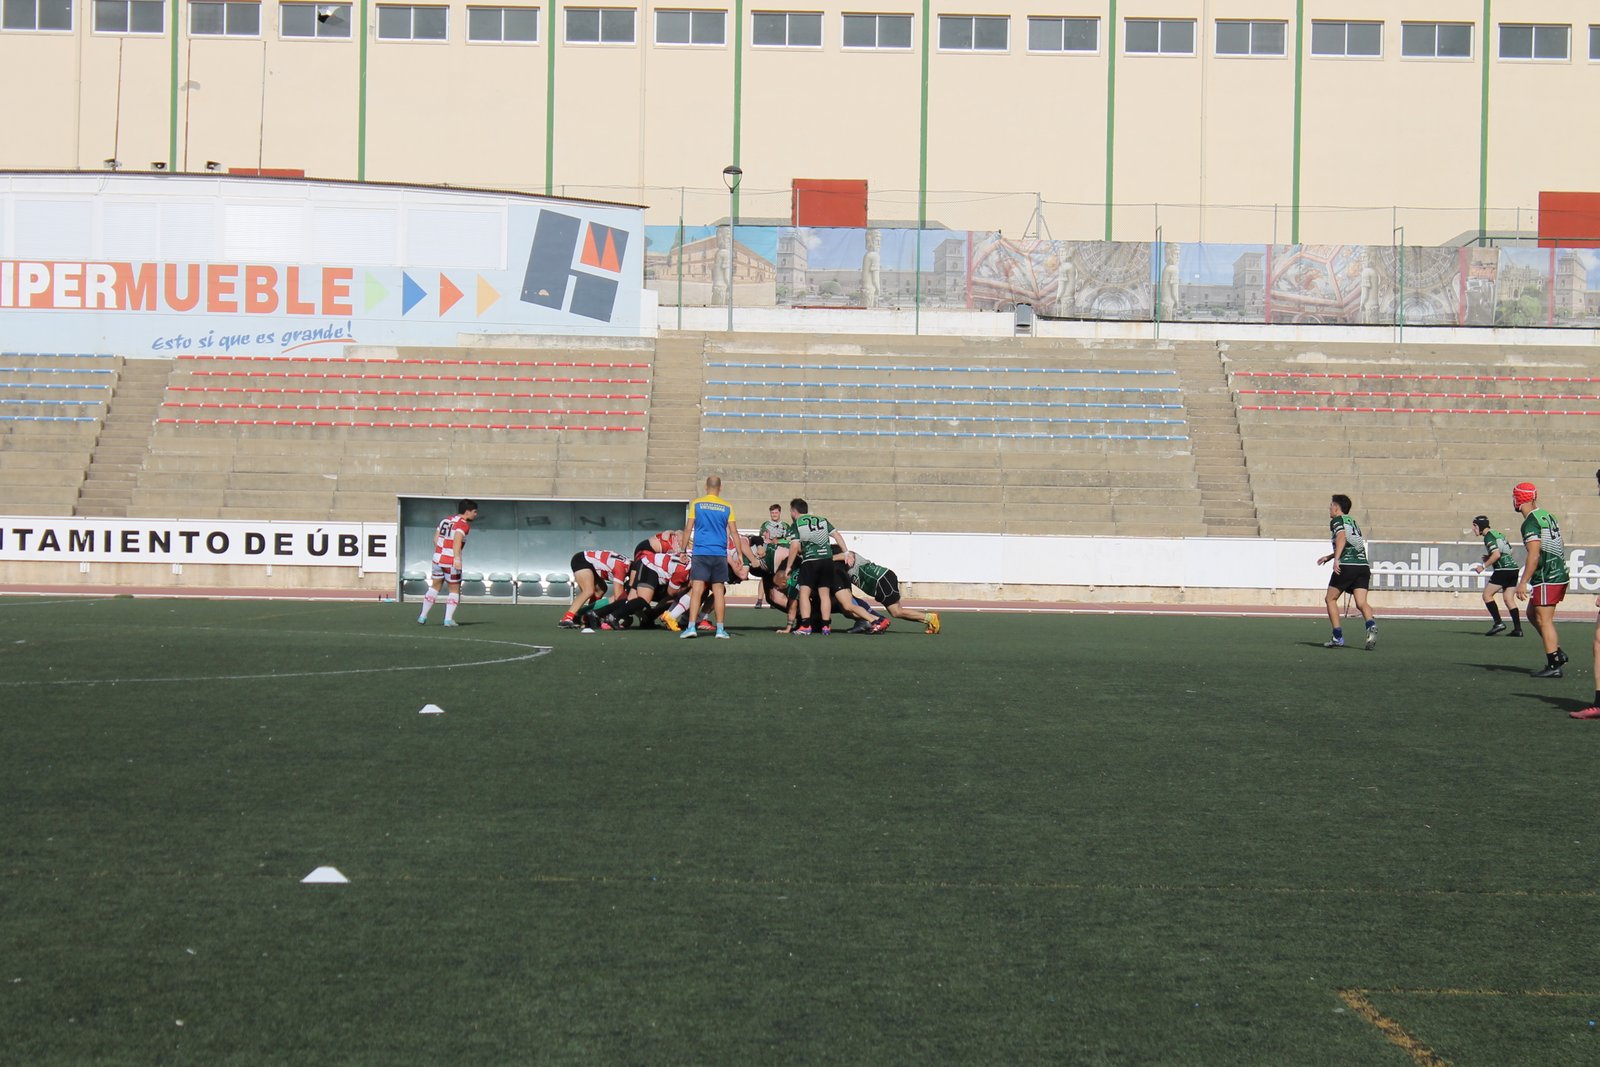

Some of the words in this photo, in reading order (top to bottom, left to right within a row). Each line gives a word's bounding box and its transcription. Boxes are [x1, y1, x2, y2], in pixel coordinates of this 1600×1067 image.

[151, 334, 192, 350] Esto
[218, 334, 250, 352] que
[256, 331, 275, 344] es
[280, 320, 353, 347] grande!
[803, 516, 824, 532] 22
[0, 527, 230, 554] TAMIENTO
[245, 532, 293, 556] DE
[307, 528, 397, 558] ÚBE
